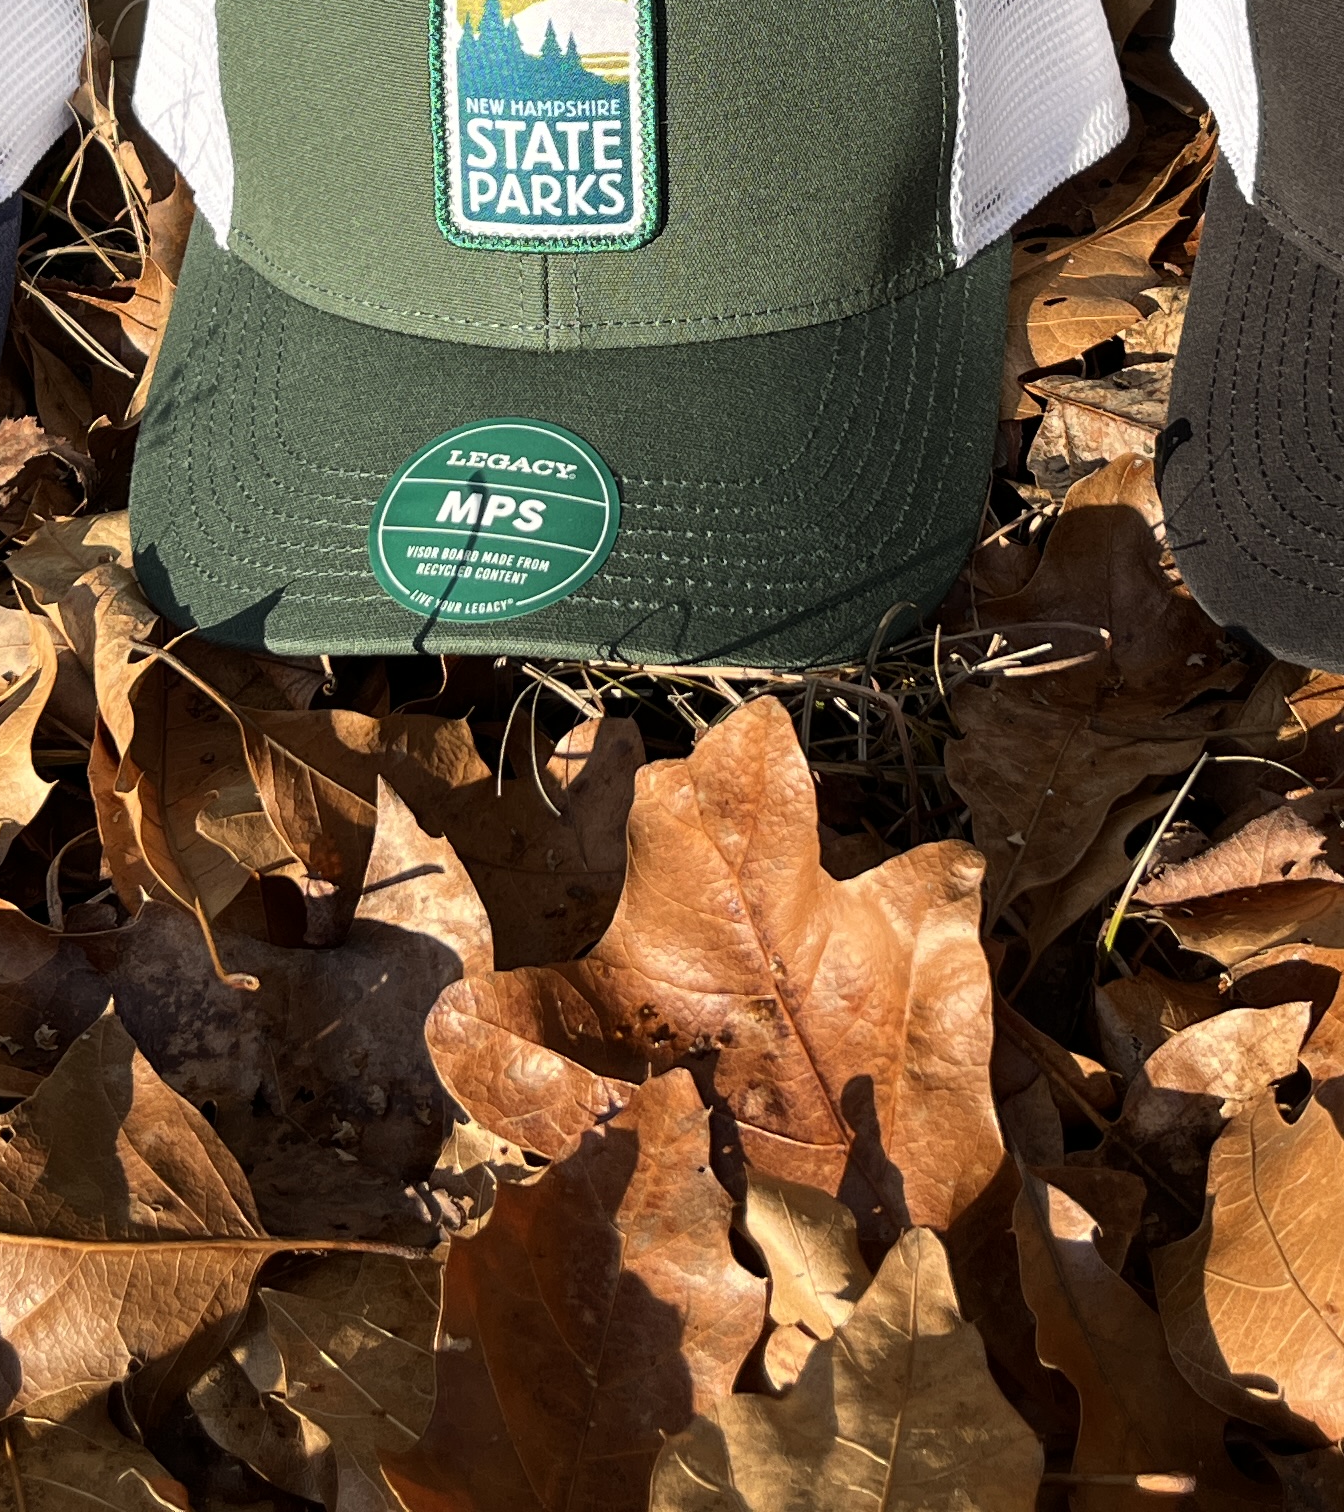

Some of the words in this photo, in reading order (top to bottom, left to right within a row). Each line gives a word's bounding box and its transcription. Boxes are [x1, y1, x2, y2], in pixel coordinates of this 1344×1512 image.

[466, 97, 505, 115] NEW
[511, 98, 621, 117] HAMPSHIRE
[466, 118, 622, 171] STATE
[467, 171, 626, 216] PARKS
[435, 490, 547, 532] MPS
[406, 545, 439, 559] VISOR
[441, 547, 478, 562] BOARD
[481, 552, 515, 567] MADE
[517, 556, 550, 572] FROM
[416, 562, 472, 578] RECYCLED
[474, 568, 528, 585] CONTENT
[409, 589, 432, 607] LIVE
[436, 599, 462, 613] YOUR
